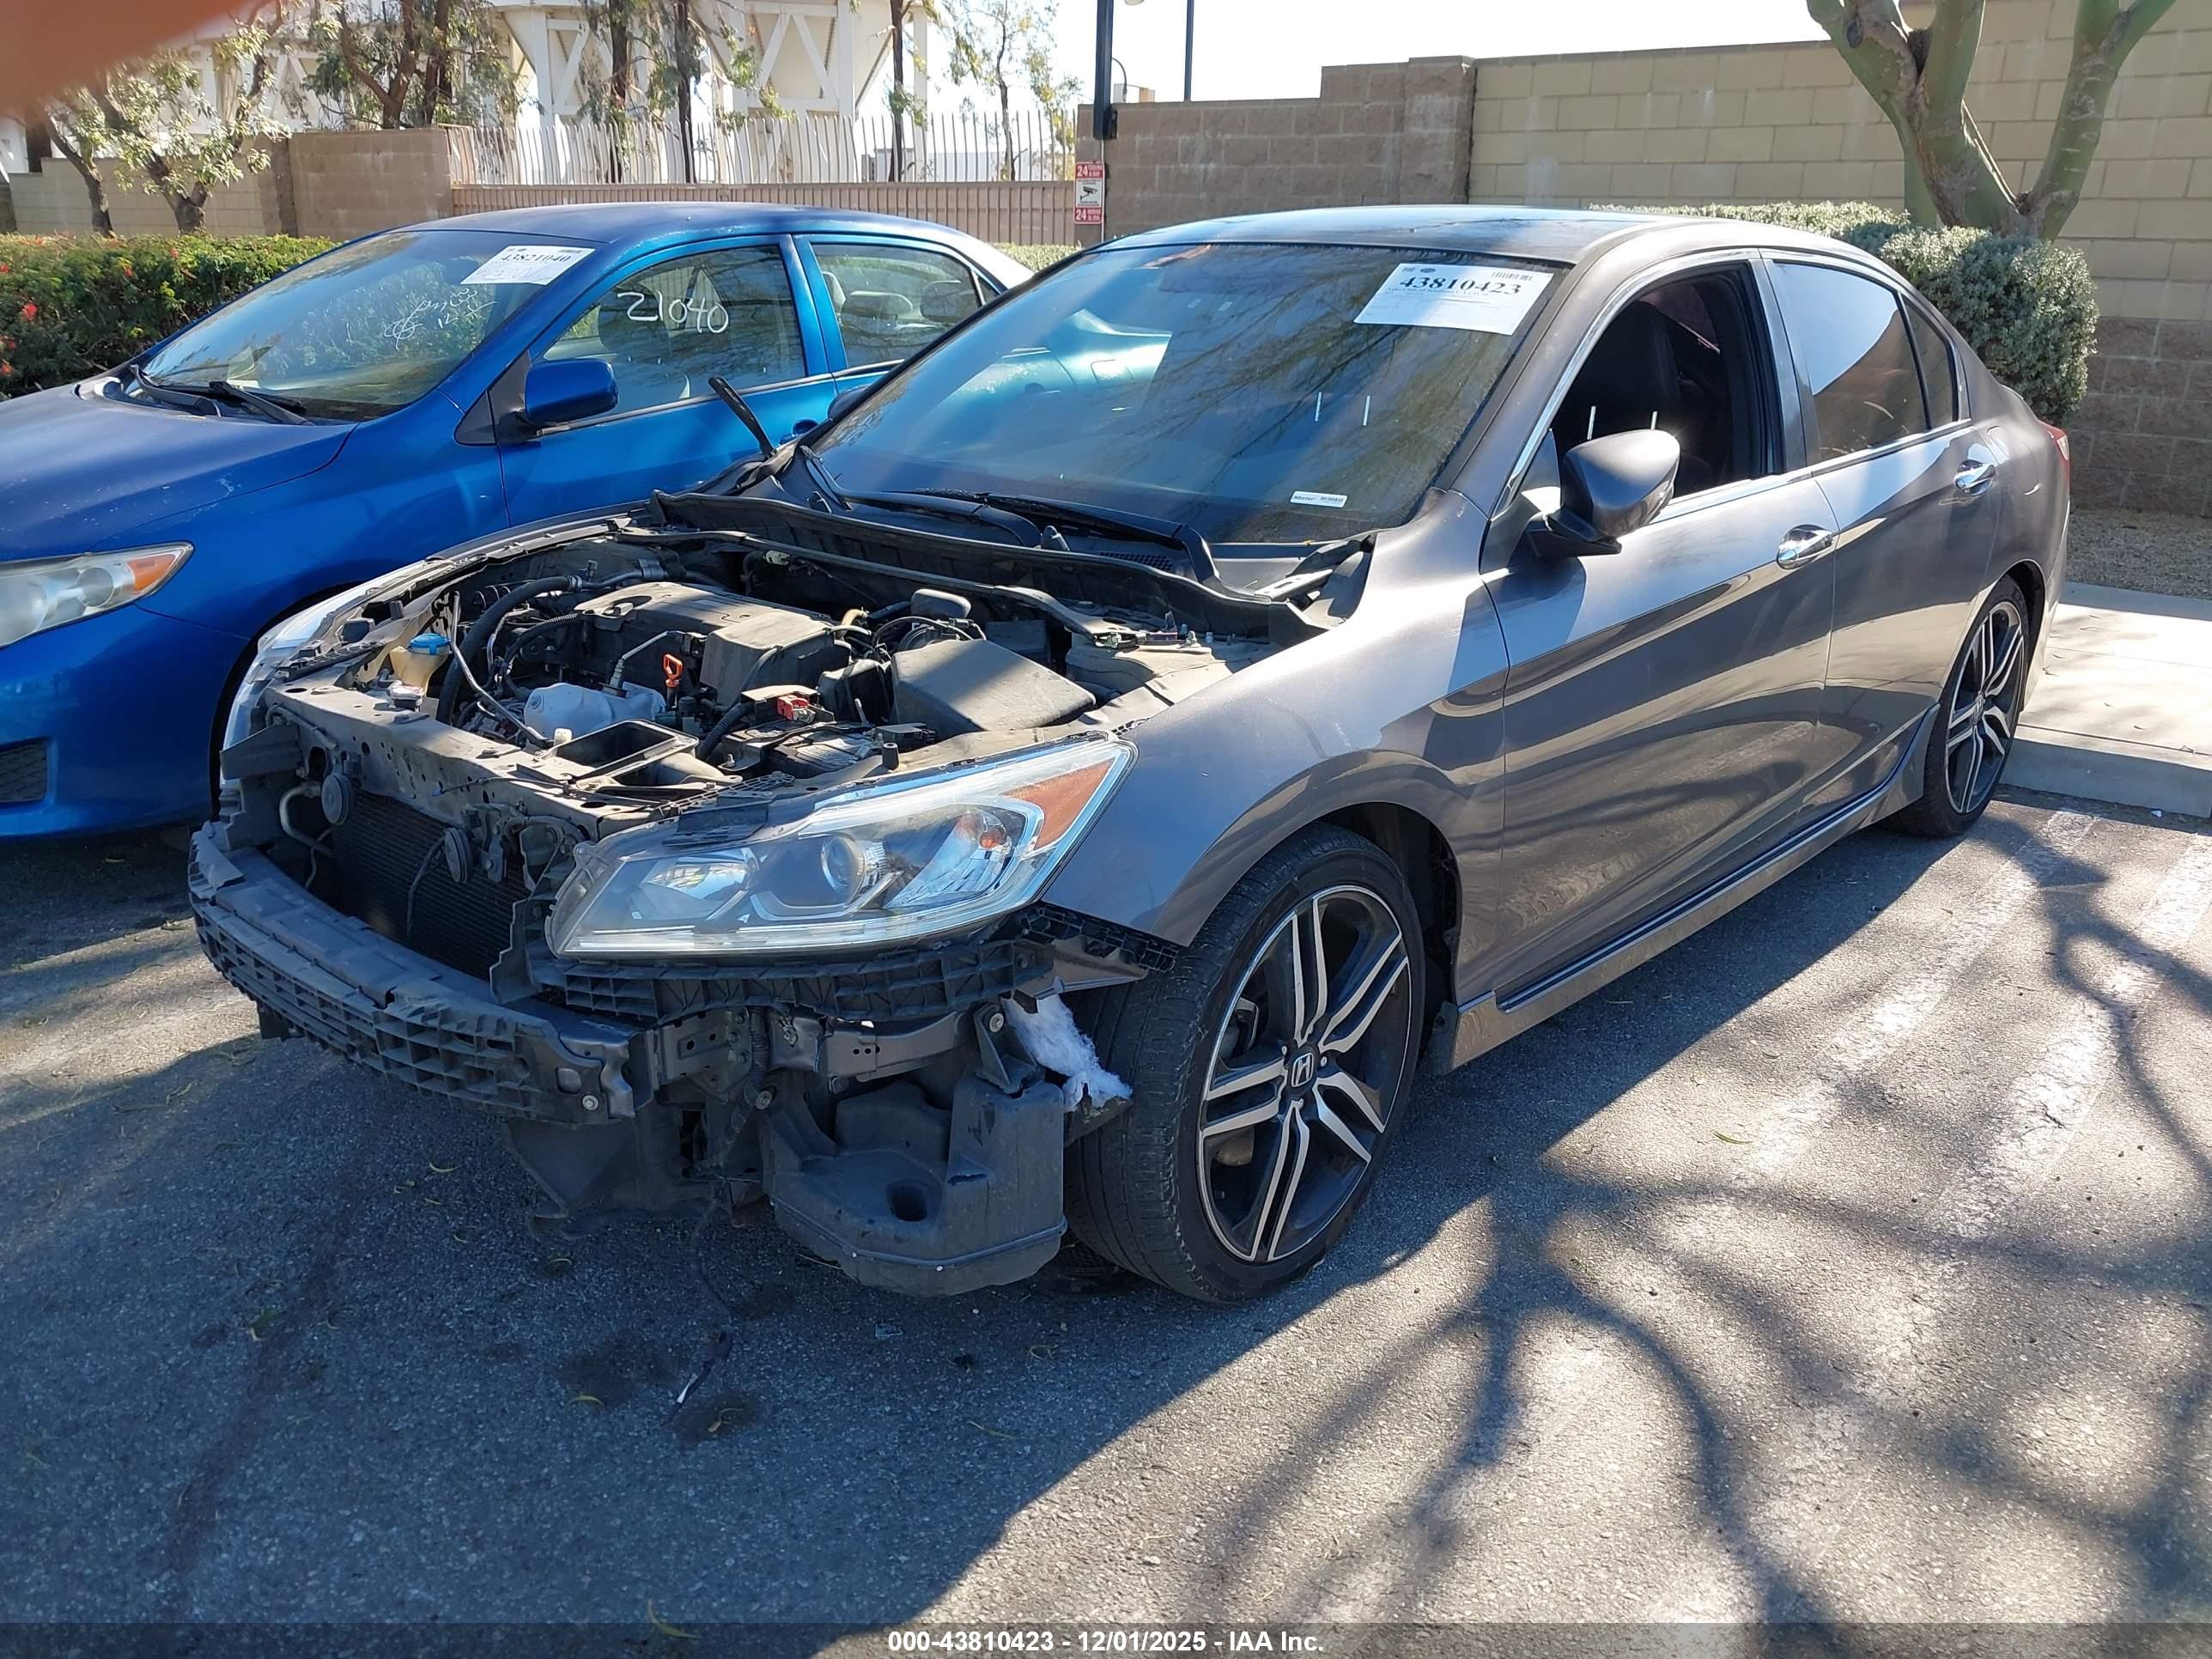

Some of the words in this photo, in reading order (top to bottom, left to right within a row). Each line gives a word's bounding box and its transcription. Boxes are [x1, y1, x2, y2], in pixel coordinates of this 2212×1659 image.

[1077, 165, 1088, 177] 24
[1076, 209, 1086, 221] 24
[501, 253, 572, 263] 43821040
[1399, 276, 1522, 295] 43810423
[617, 290, 729, 334] 21040
